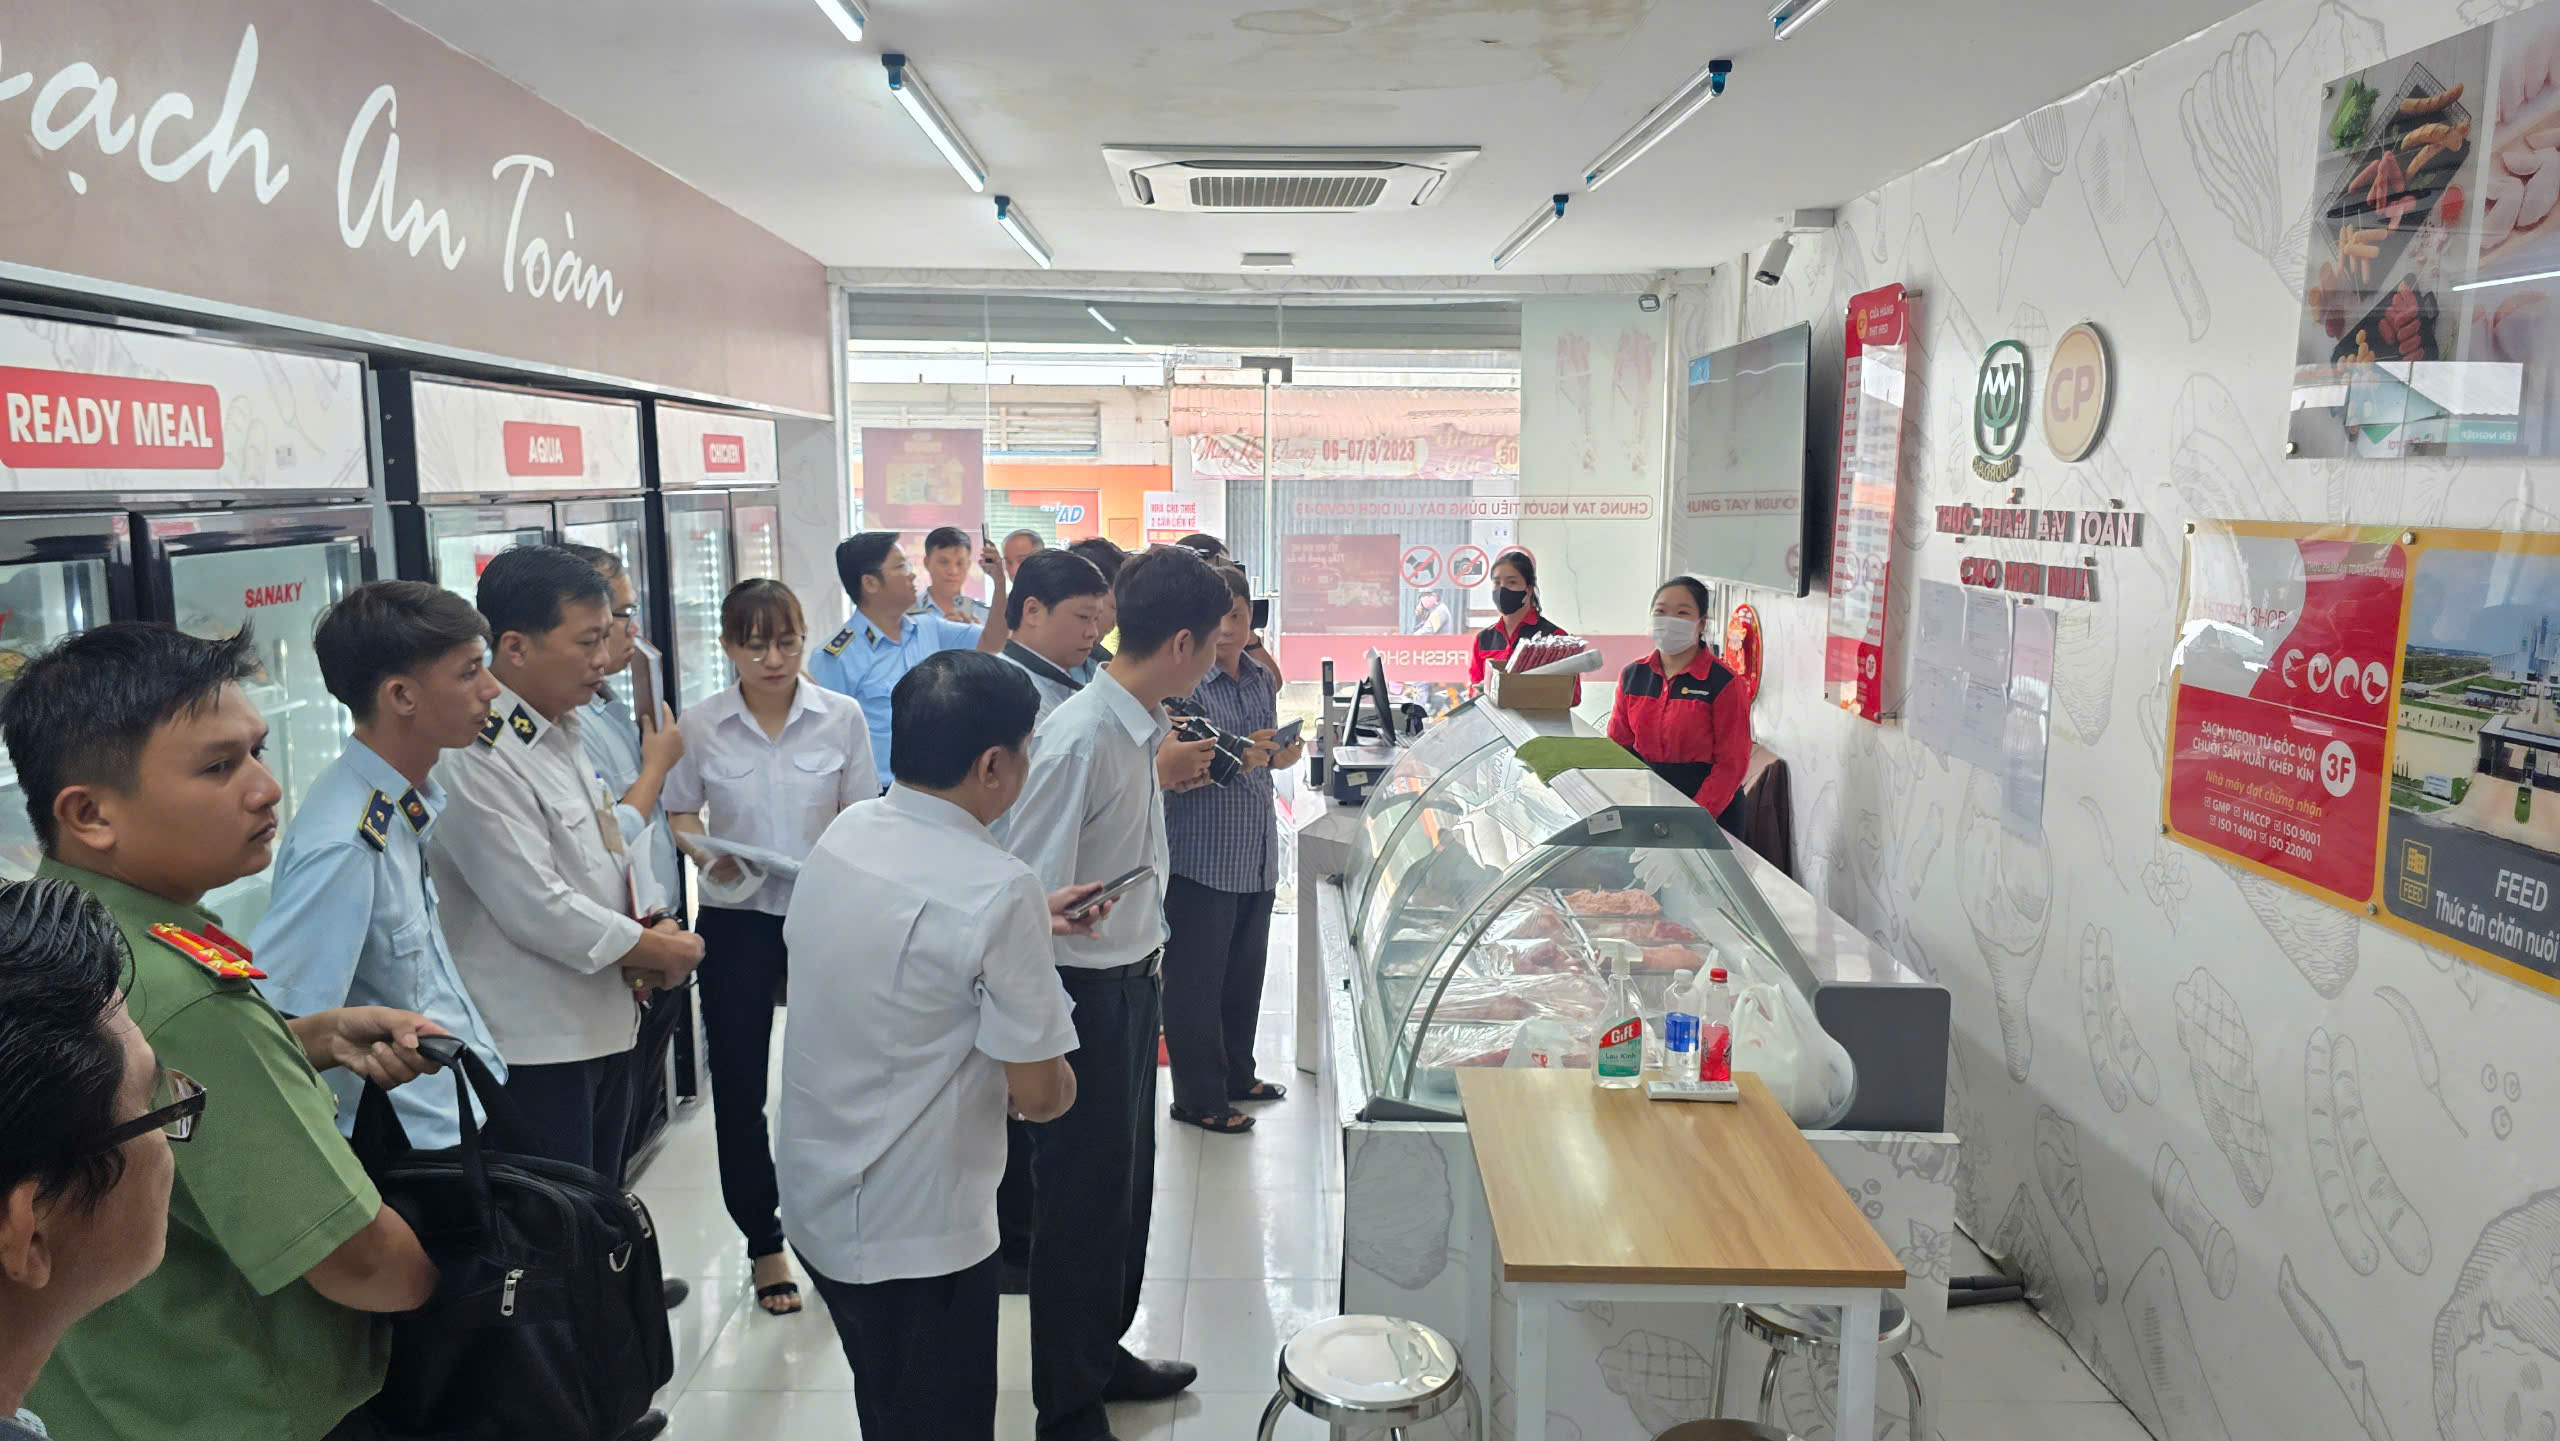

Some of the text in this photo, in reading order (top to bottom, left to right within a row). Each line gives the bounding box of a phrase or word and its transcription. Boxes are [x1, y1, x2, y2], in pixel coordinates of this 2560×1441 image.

[0, 23, 290, 205] ạch
[492, 154, 624, 317] Toàn
[2051, 365, 2095, 422] CP
[6, 392, 213, 448] READY MEAL
[528, 436, 564, 463] AQUA
[709, 442, 741, 465] CHICKEN
[1322, 439, 1415, 465] 06-07/3/2023
[2040, 509, 2067, 542] AN
[2076, 499, 2135, 547] TOÀN
[244, 582, 303, 608] SANAKY
[1961, 557, 1998, 588] CHO
[2048, 557, 2092, 601] NHÀ
[2250, 606, 2288, 630] SHOP
[2228, 728, 2256, 748] NGON
[2274, 735, 2296, 756] GỐC
[2297, 744, 2316, 762] VỚI
[2242, 747, 2266, 768] XUẤT
[2268, 757, 2294, 776] KHÉP
[2296, 764, 2315, 783] KÍN
[2326, 753, 2352, 783] 3F
[2205, 770, 2323, 818] Nhà máy đạt chứng nhận
[2212, 799, 2321, 847] GMP HACCP ISO 9001
[2218, 817, 2312, 862] ISO 14001 ISO 22000
[2403, 882, 2424, 902] FEED
[2495, 869, 2548, 912] FEED
[2436, 890, 2560, 963] Thức ăn chăn nuôi
[1611, 1024, 1633, 1044] Gift
